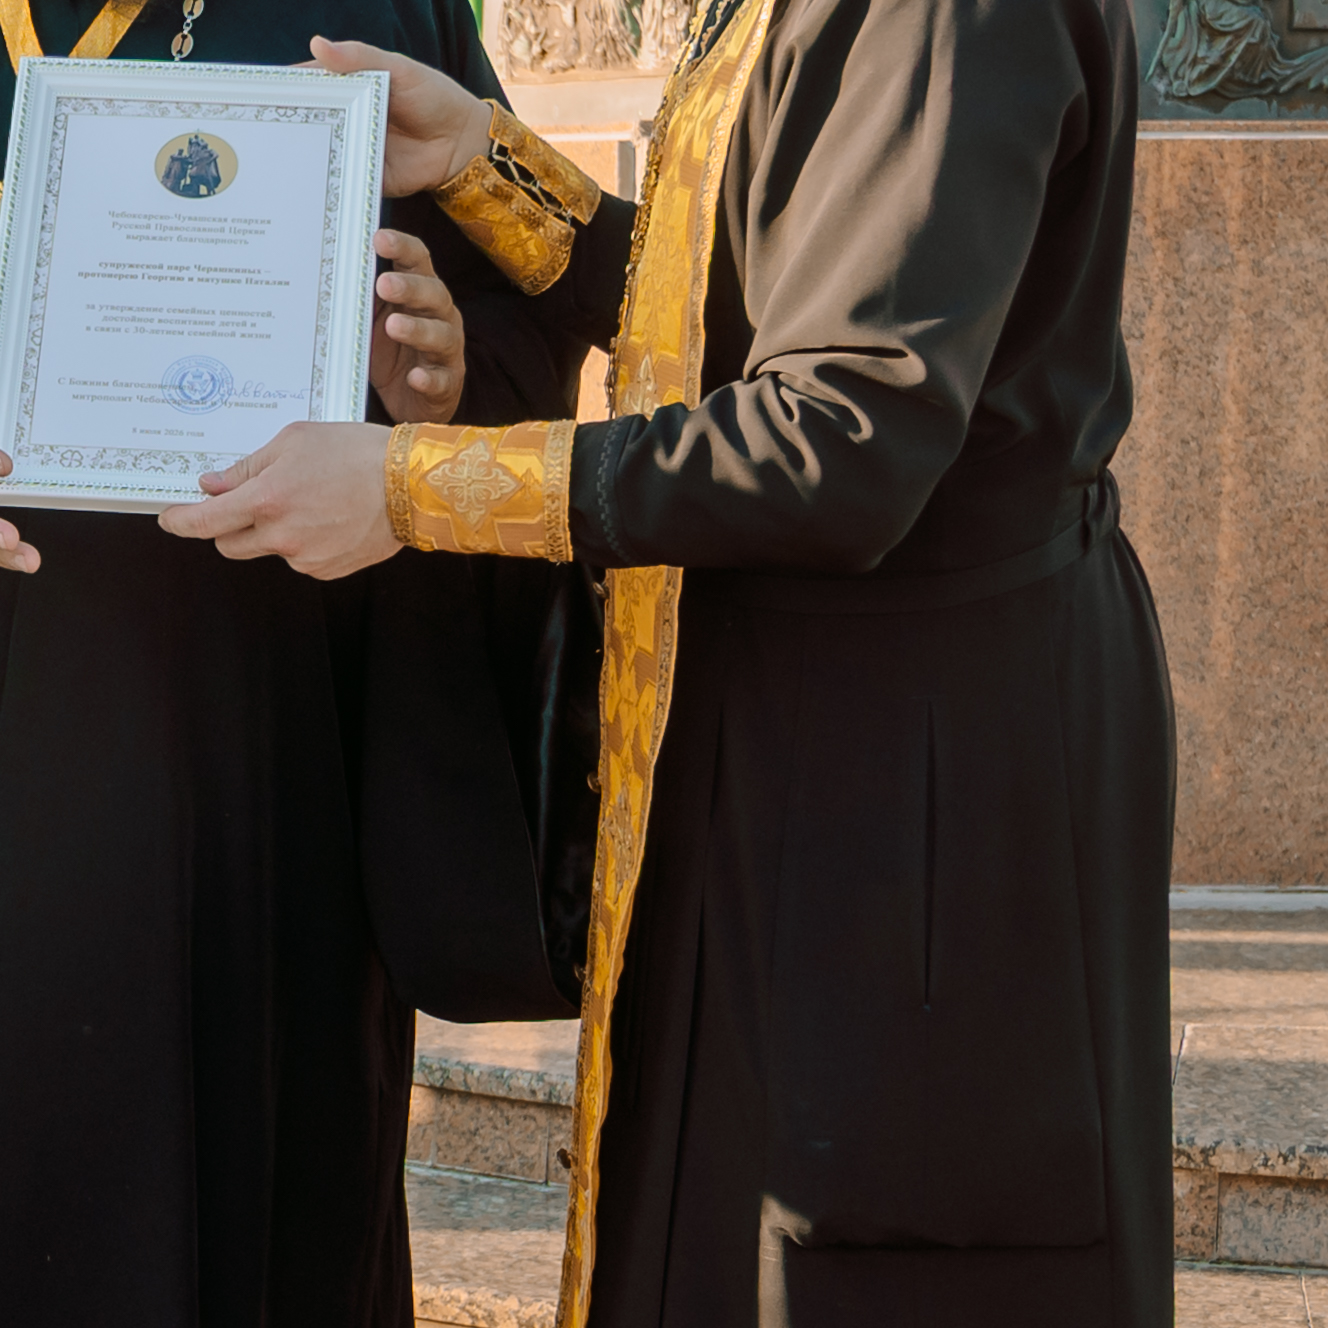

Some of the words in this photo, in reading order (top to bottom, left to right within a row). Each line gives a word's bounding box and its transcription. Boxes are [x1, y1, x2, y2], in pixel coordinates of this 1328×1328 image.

[108, 210, 228, 222] Чебоксарско-Чувашская
[231, 217, 272, 226] епархия
[112, 221, 151, 230] Русской
[154, 223, 225, 233] Православной
[228, 227, 266, 236] Церкви
[125, 233, 174, 242] выражает
[176, 234, 249, 245] благодарность
[98, 260, 164, 270] супружеской
[166, 264, 191, 272] паре
[77, 270, 139, 280] протоиерею
[141, 272, 185, 282] Георгию
[197, 276, 242, 285] матушке
[85, 303, 96, 311] за
[98, 304, 164, 313] утверждение
[166, 307, 216, 315] семейных
[219, 309, 276, 319] ценностей,
[101, 315, 155, 324] достойное
[157, 317, 216, 326] воспитание
[218, 320, 247, 329] детей
[133, 325, 185, 336] 30-летием
[187, 329, 236, 338] семейной
[57, 377, 67, 386] С
[69, 378, 109, 387] Божиим
[72, 393, 133, 403] митрополит
